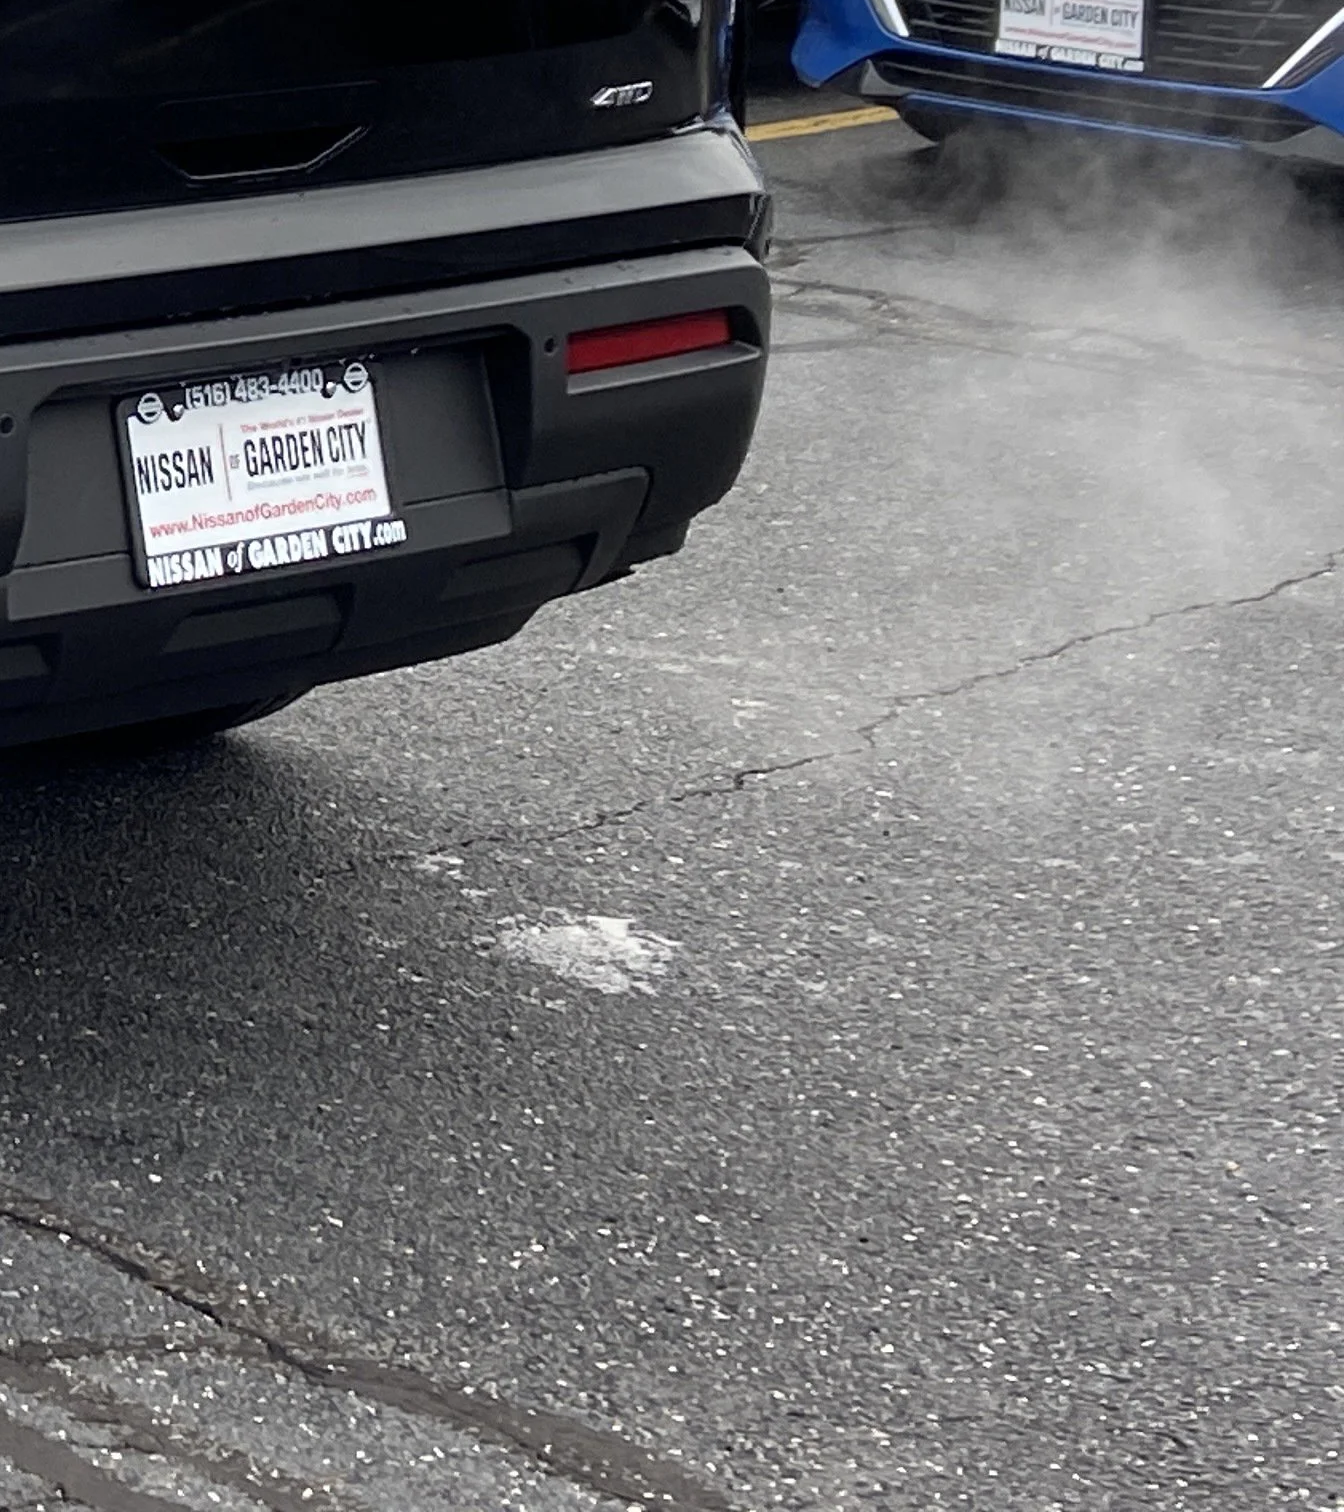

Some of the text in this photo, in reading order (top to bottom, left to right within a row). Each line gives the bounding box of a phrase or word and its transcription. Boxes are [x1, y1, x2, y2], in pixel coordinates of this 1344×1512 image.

[1111, 8, 1140, 29] CITY
[185, 368, 324, 410] (516) 483-4400
[136, 445, 214, 495] NISSAN
[243, 428, 325, 478] GARDEN
[327, 421, 367, 464] CITY
[150, 486, 377, 539] www.NissanofGardenCity.com
[147, 547, 224, 588] NISSAN
[227, 542, 245, 573] of
[248, 529, 329, 570] GARDEN
